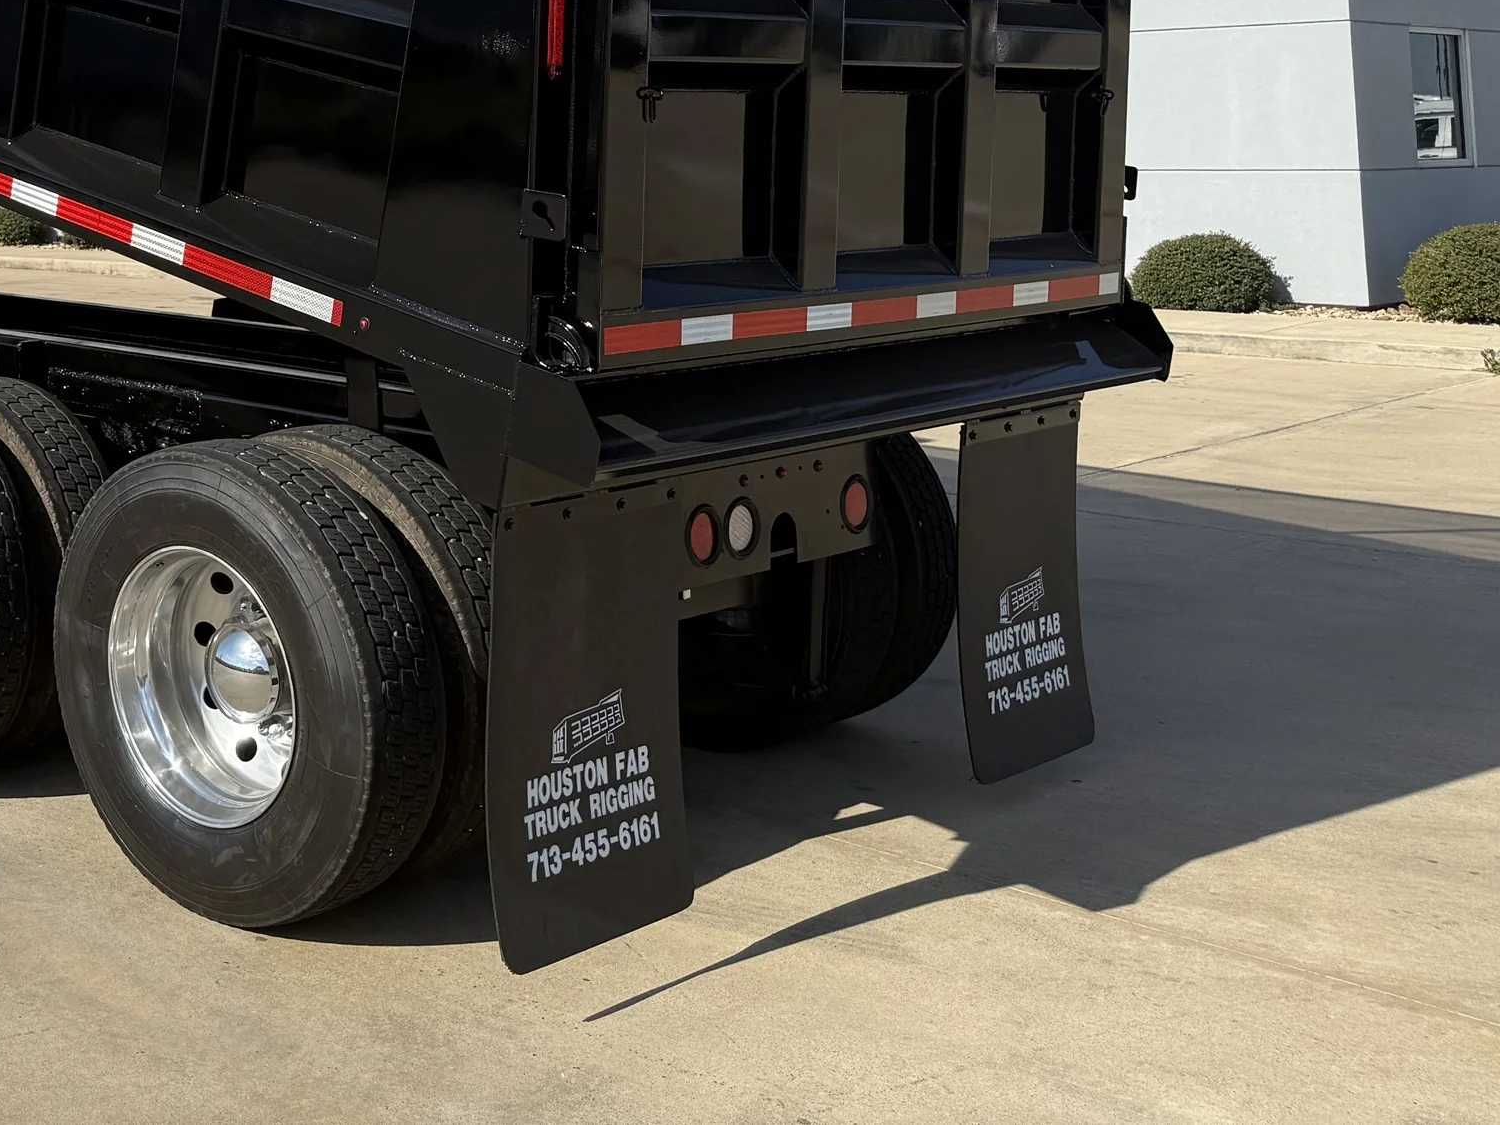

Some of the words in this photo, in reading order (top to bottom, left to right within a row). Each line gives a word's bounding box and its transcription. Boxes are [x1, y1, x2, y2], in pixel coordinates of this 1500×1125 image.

[985, 620, 1036, 658] HOUSTON
[1039, 612, 1061, 639] FAB
[985, 651, 1022, 682] TRUCK
[1025, 637, 1066, 669] RIGGING
[988, 664, 1071, 715] 713-455-6161
[526, 756, 608, 809] HOUSTON
[615, 745, 650, 781] FAB
[524, 798, 583, 841] TRUCK
[589, 776, 656, 820] RIGGING
[526, 811, 661, 883] 713-455-6161
